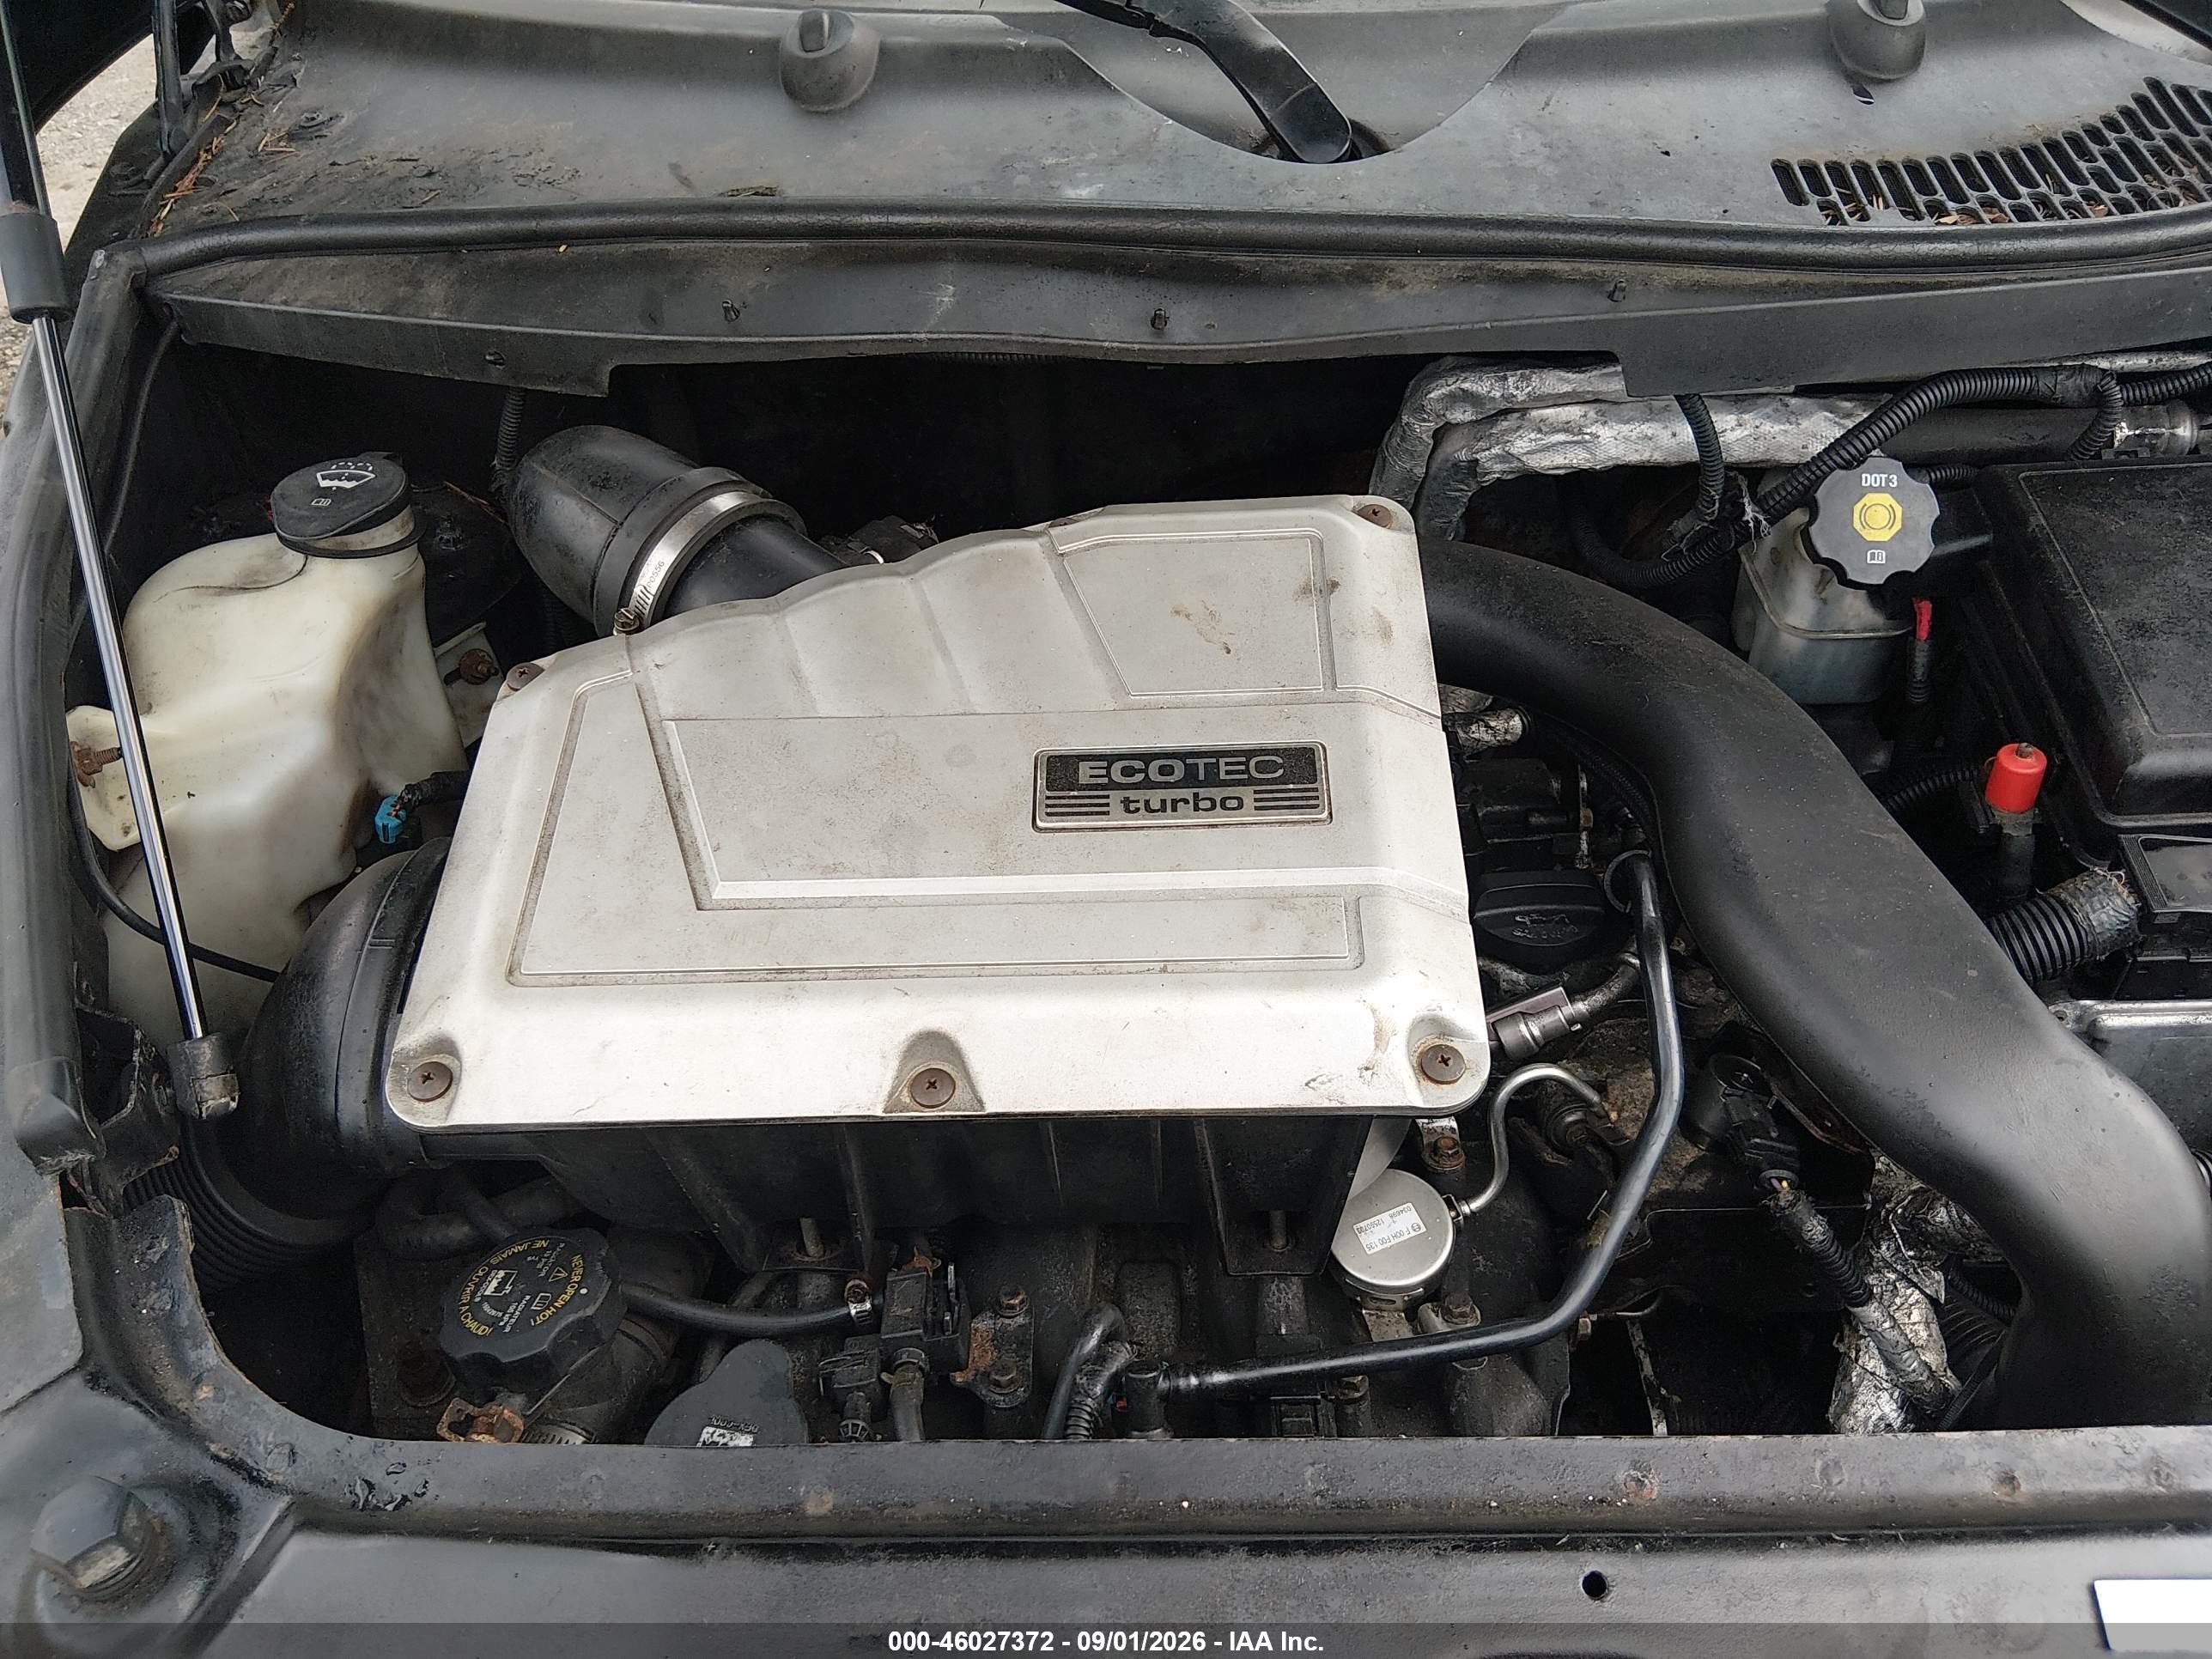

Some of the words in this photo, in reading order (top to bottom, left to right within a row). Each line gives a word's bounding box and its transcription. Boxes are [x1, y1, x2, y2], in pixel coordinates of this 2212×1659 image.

[1861, 473, 1888, 487] DOT
[1888, 474, 1898, 488] 3
[1079, 755, 1285, 784] ECOTEC
[1120, 792, 1244, 815] turbo
[489, 1242, 532, 1265] JAMAIS
[531, 1239, 550, 1249] NE
[570, 1254, 585, 1283] NEVER
[459, 1266, 489, 1305] OUVRIR
[553, 1283, 579, 1309] OPEN
[461, 1312, 494, 1337] CHAUD!
[502, 1294, 532, 1333] RADIATEUR
[530, 1306, 557, 1327] HOT!
